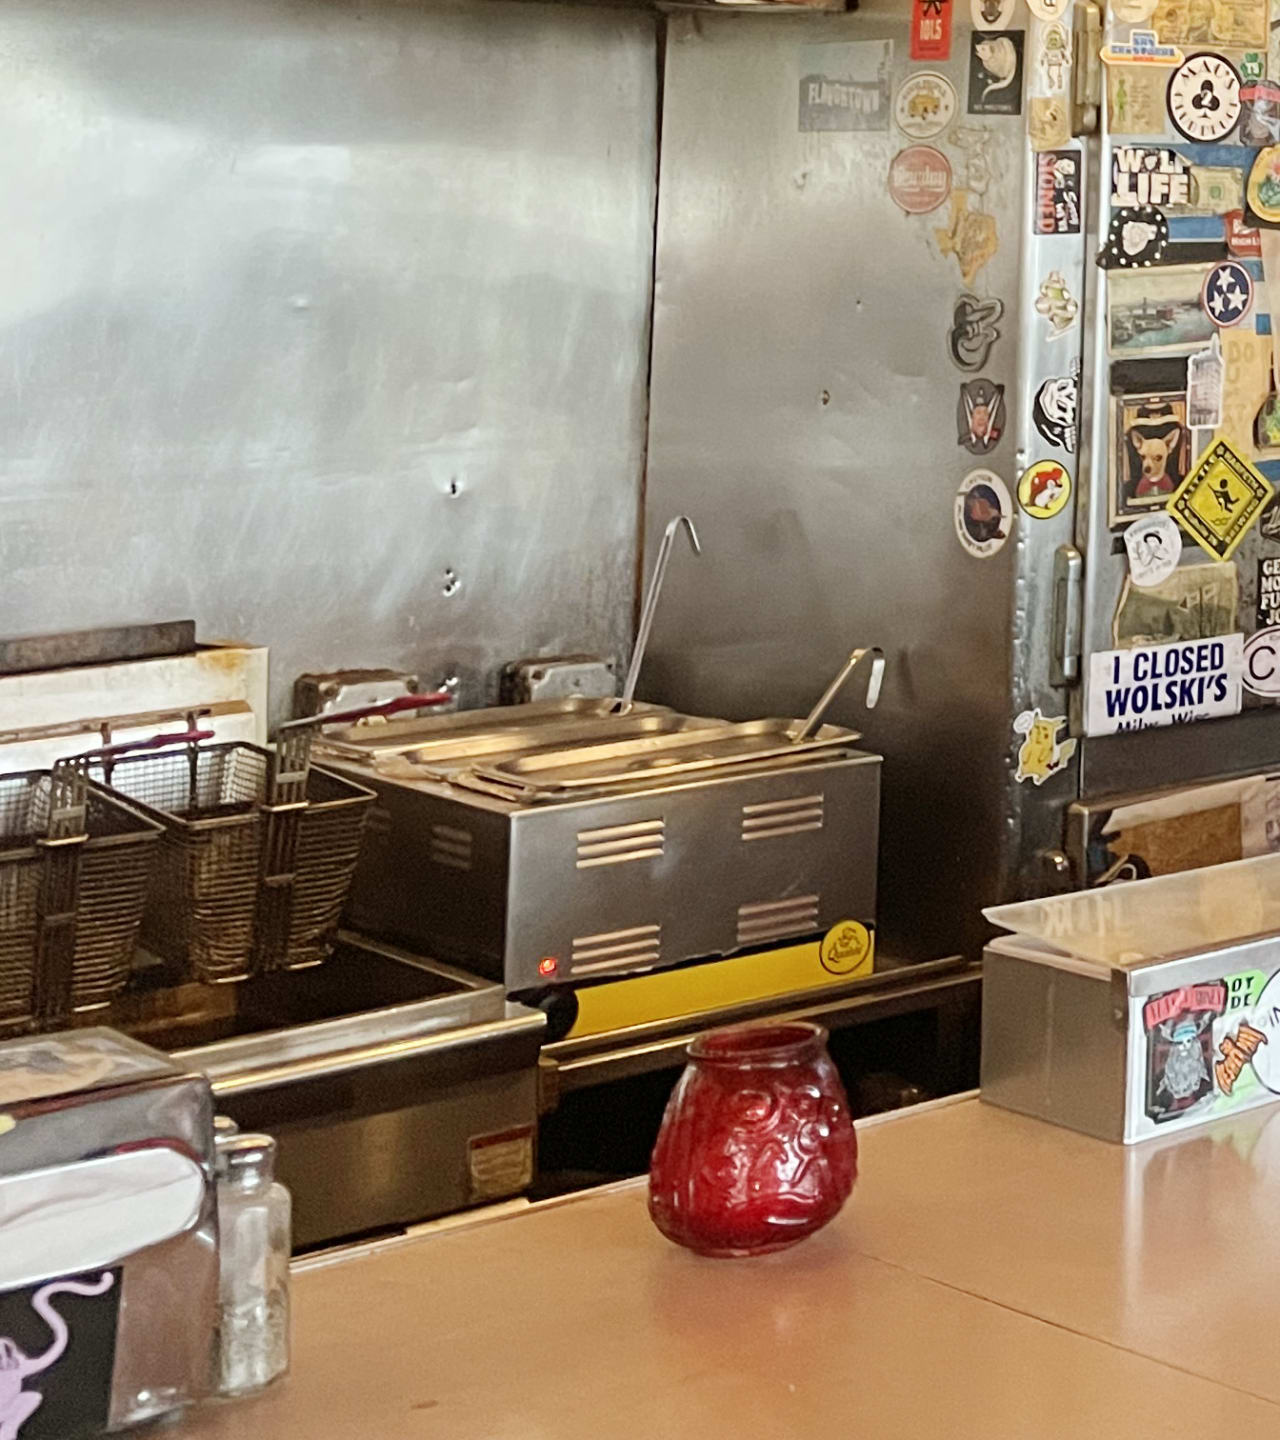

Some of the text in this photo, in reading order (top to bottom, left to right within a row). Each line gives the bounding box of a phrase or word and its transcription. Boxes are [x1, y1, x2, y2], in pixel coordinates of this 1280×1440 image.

[1117, 172, 1189, 207] LIFE
[1113, 642, 1224, 684] I CLOSED
[1105, 673, 1228, 718] WOLSKI'S
